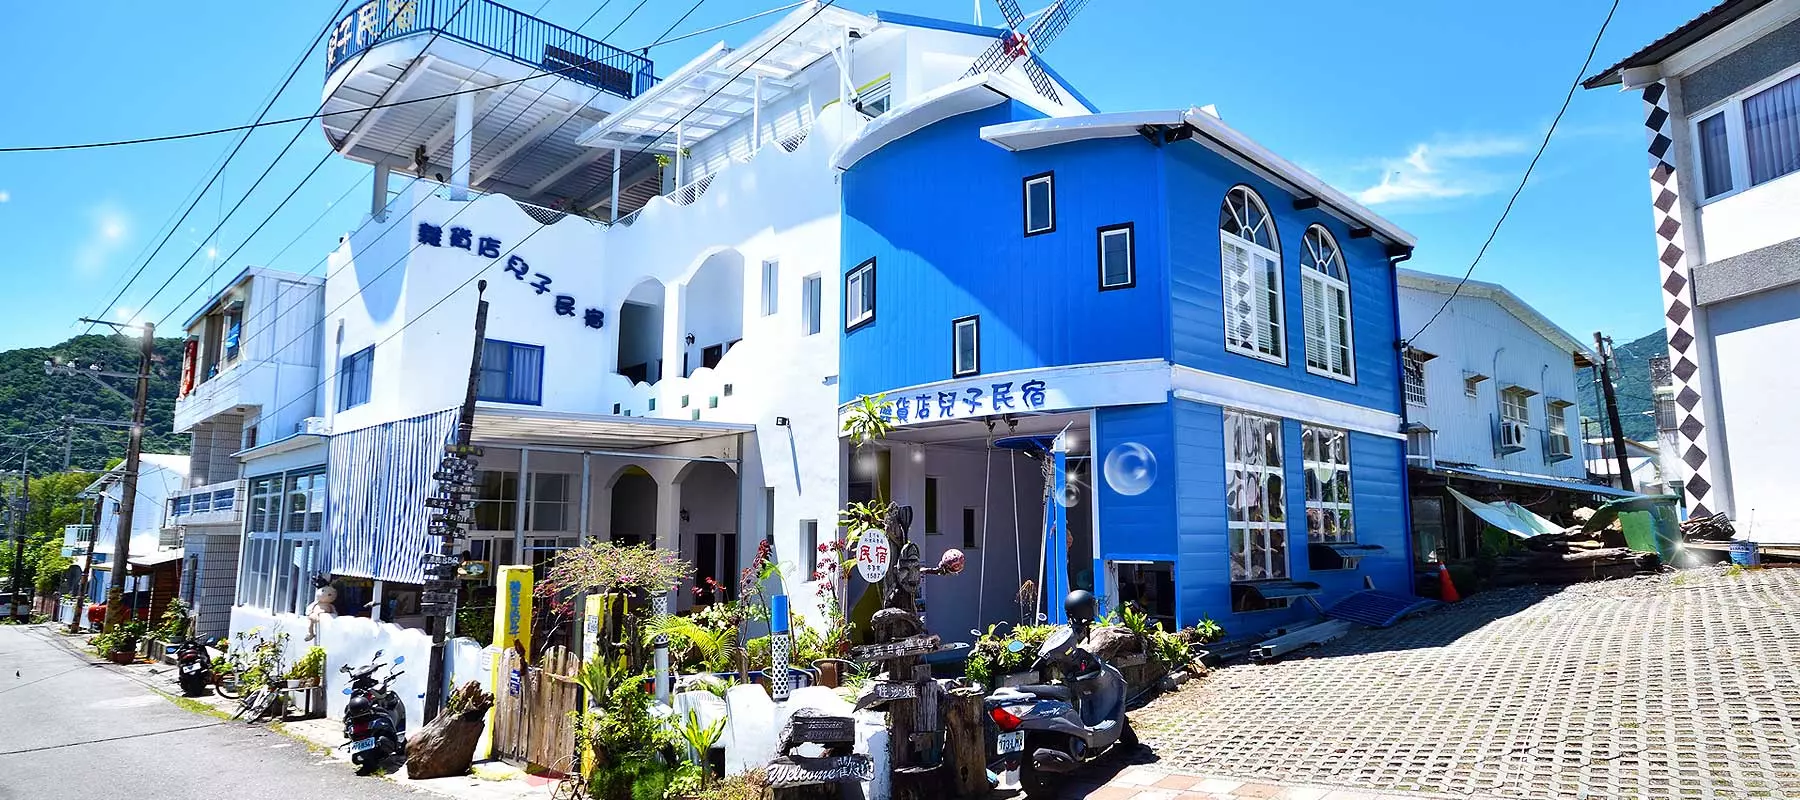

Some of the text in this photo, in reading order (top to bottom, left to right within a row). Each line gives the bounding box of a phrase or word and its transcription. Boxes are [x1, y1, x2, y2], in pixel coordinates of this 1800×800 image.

[418, 222, 605, 329] 雜貨店兒子民宿
[859, 545, 888, 564] 民宿
[768, 763, 836, 784] Welcome
